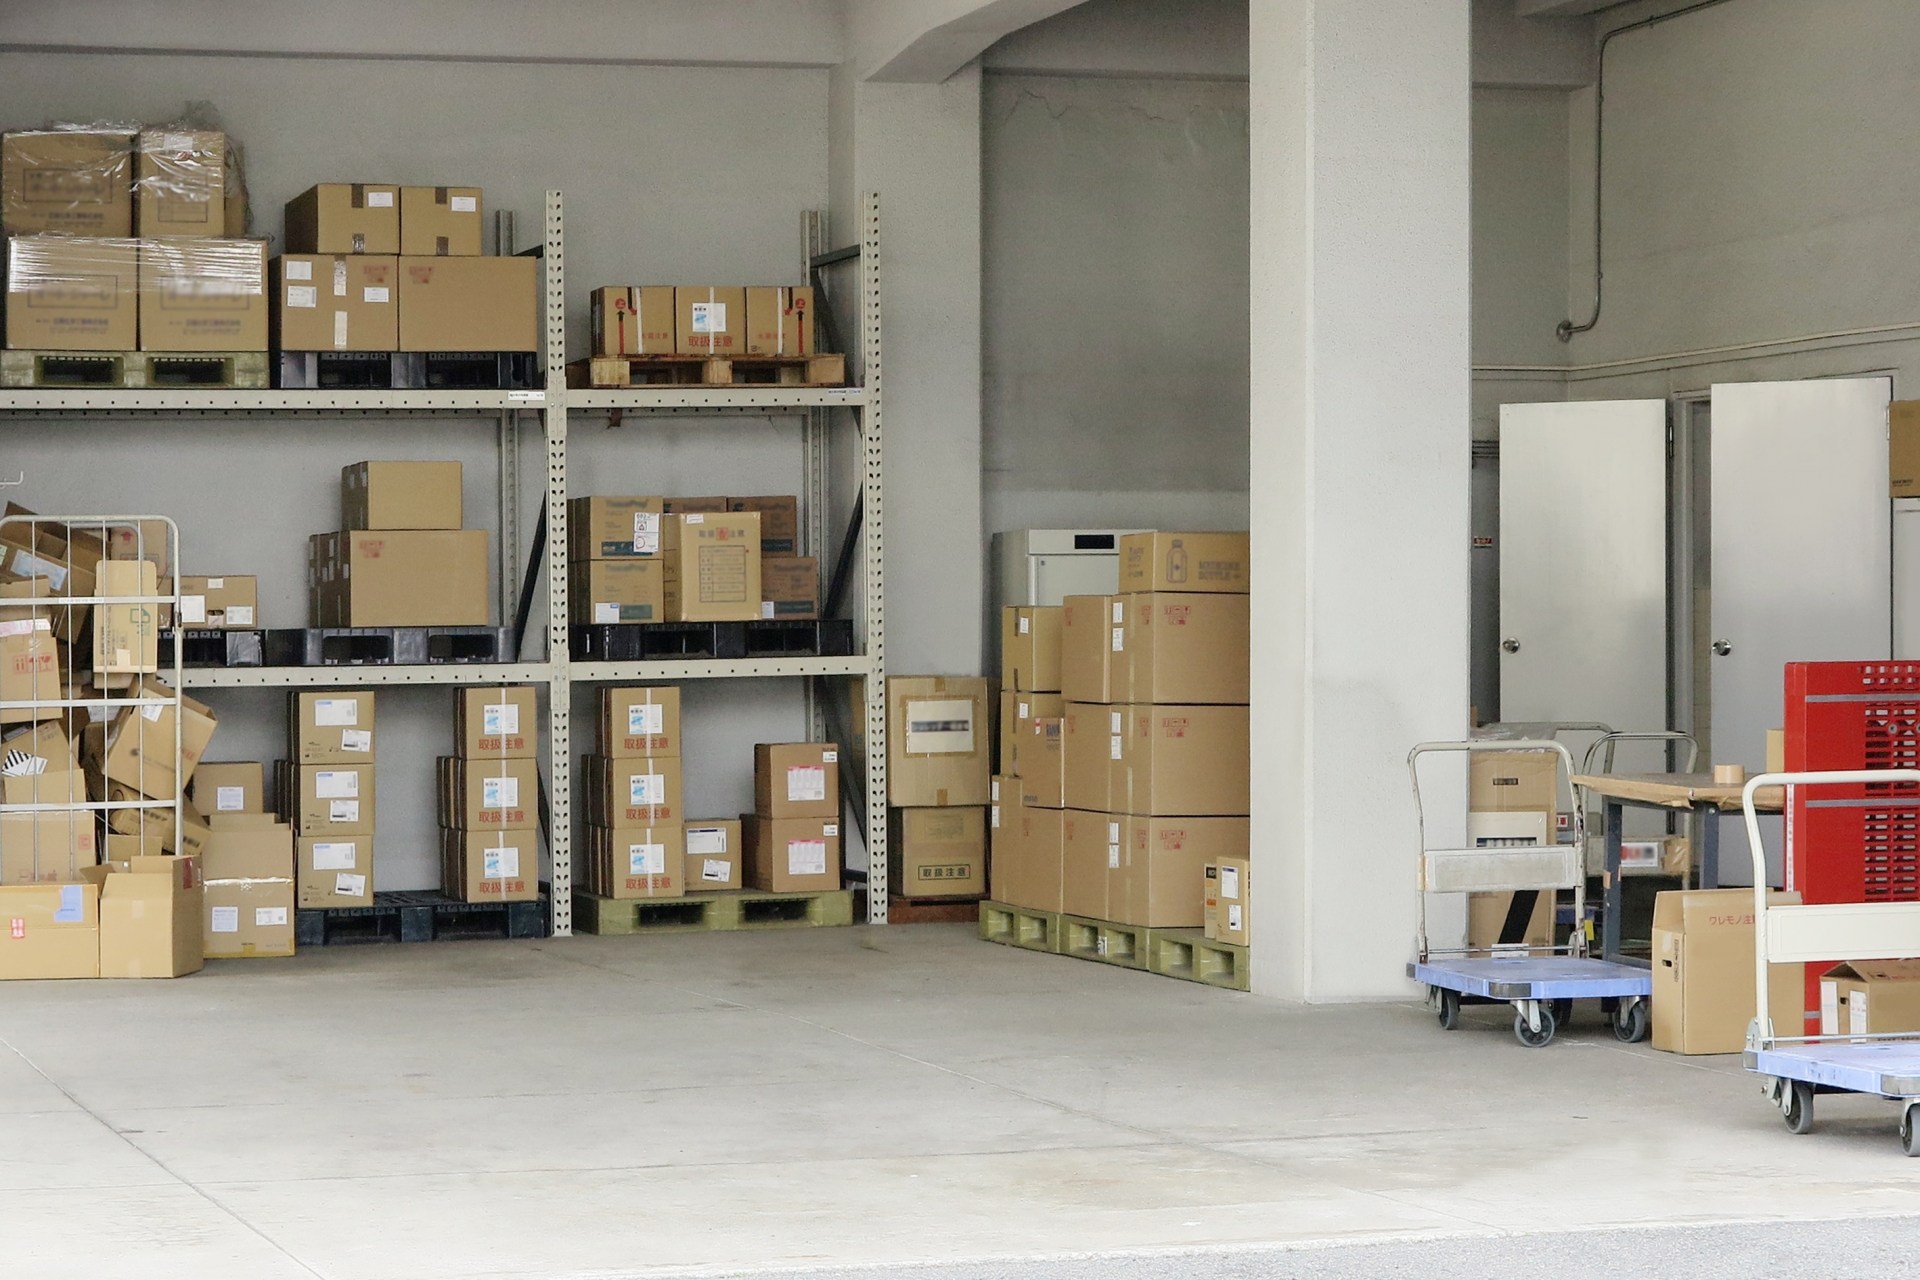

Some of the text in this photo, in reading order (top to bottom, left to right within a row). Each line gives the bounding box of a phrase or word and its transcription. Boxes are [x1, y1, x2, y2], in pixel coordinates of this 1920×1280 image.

[688, 335, 733, 348] 取扱注意
[478, 738, 524, 750] 取扱注意
[624, 737, 669, 749] 取扱注意
[479, 811, 525, 822] 取扱注意
[626, 807, 671, 820] 取扱注意
[922, 867, 966, 877] 取扱注意
[479, 881, 525, 893] 取扱注意
[626, 877, 671, 889] 取扱注意
[1709, 915, 1755, 925] ワレモノ注
